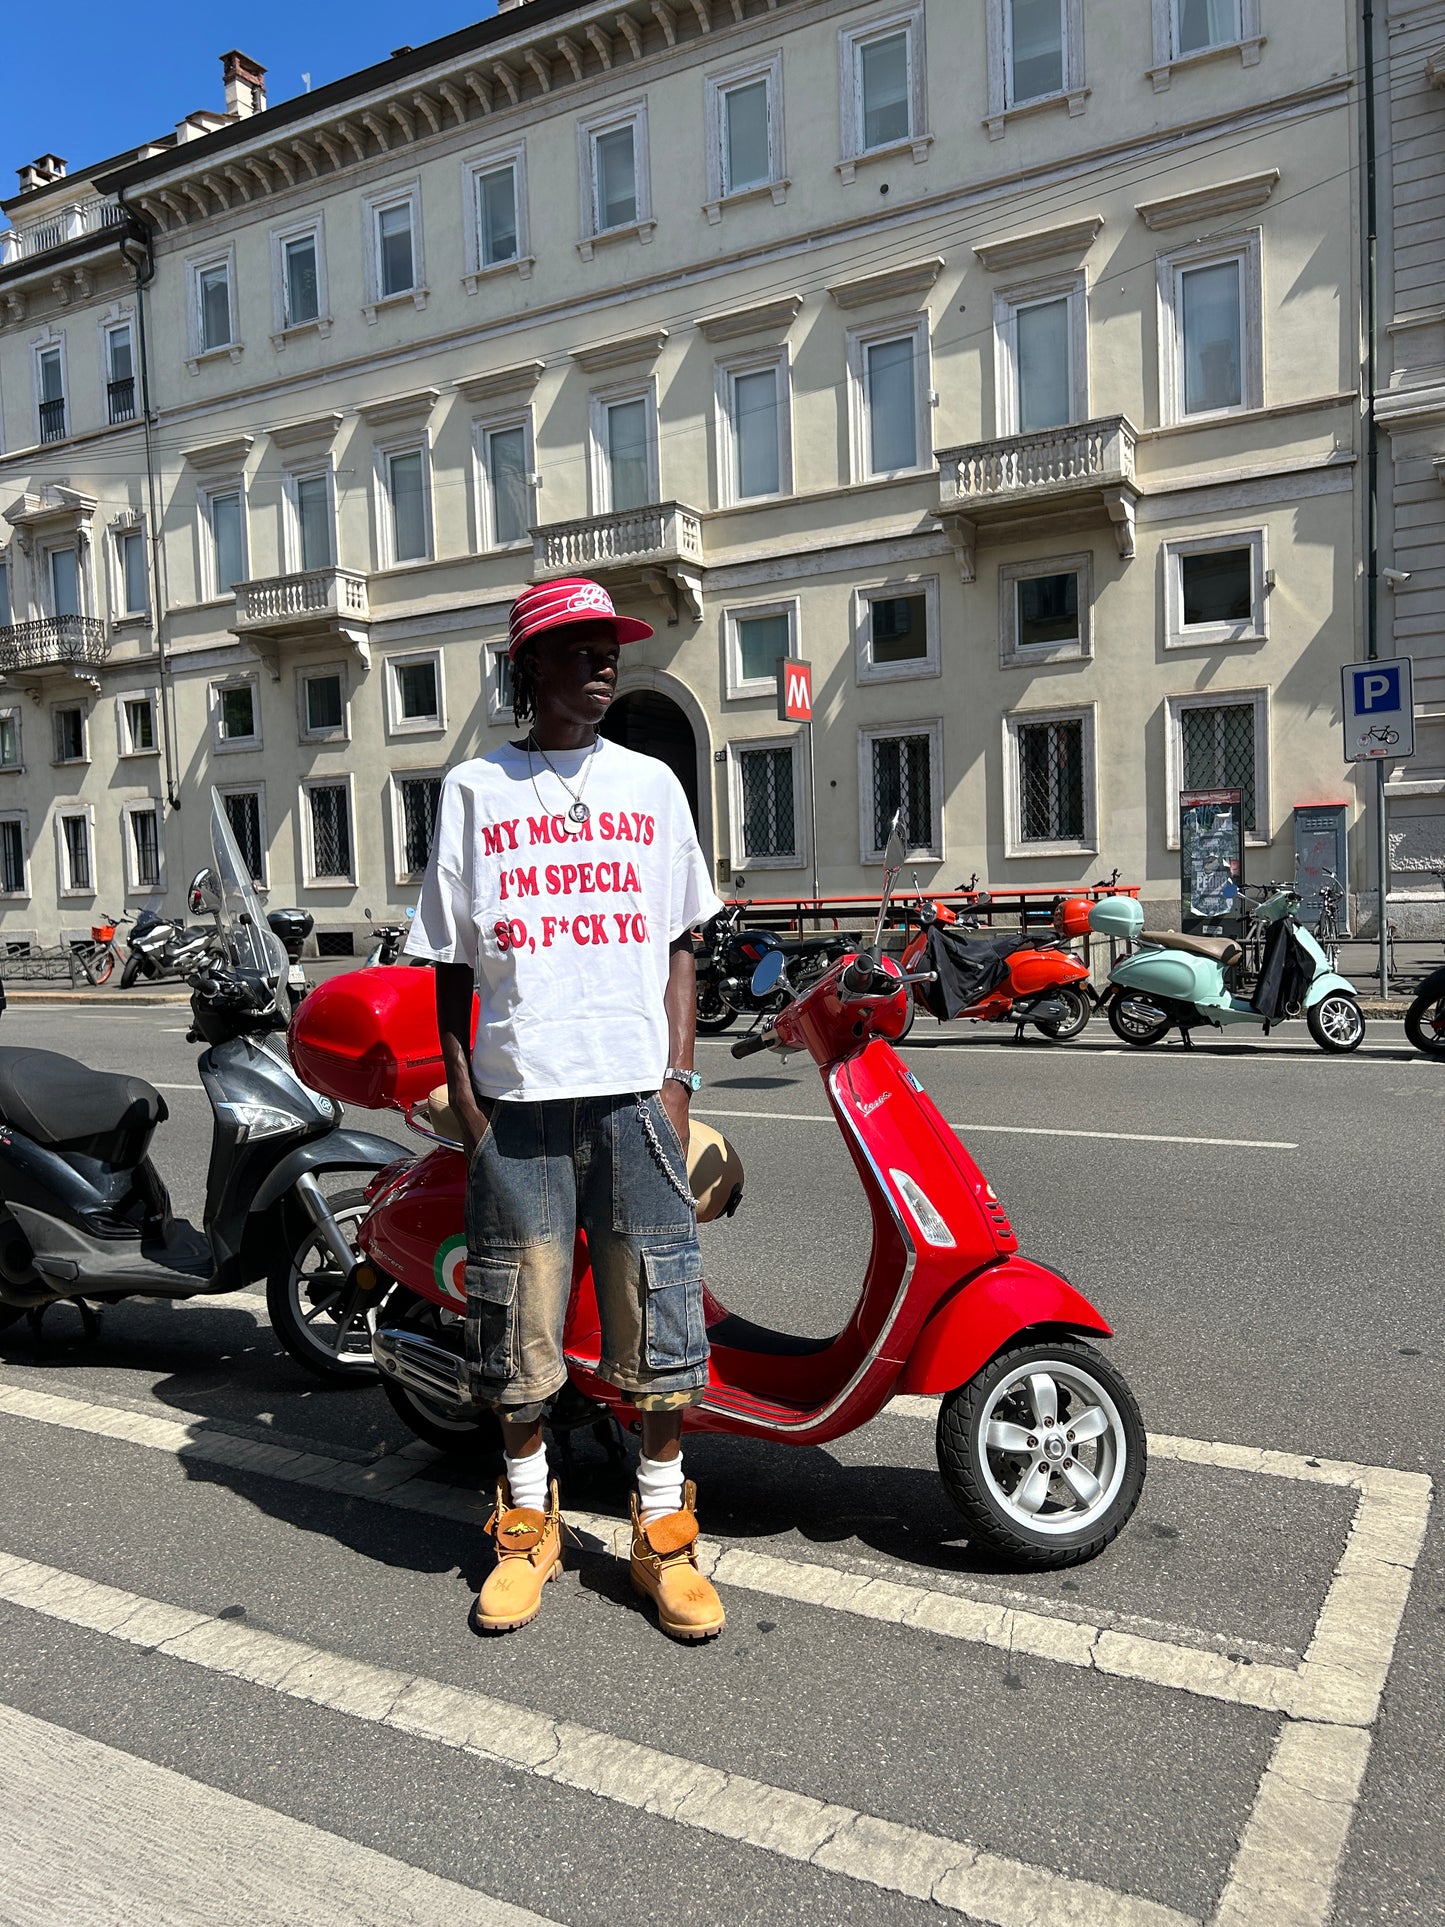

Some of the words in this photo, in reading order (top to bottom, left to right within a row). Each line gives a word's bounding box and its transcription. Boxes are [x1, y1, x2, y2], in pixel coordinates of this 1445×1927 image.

[788, 674, 810, 710] M
[1363, 675, 1390, 709] P
[481, 818, 520, 856] MY
[599, 811, 655, 846] SAYS
[544, 862, 641, 896] SPECIA
[613, 912, 650, 944] YO
[856, 1090, 893, 1118] Vespa
